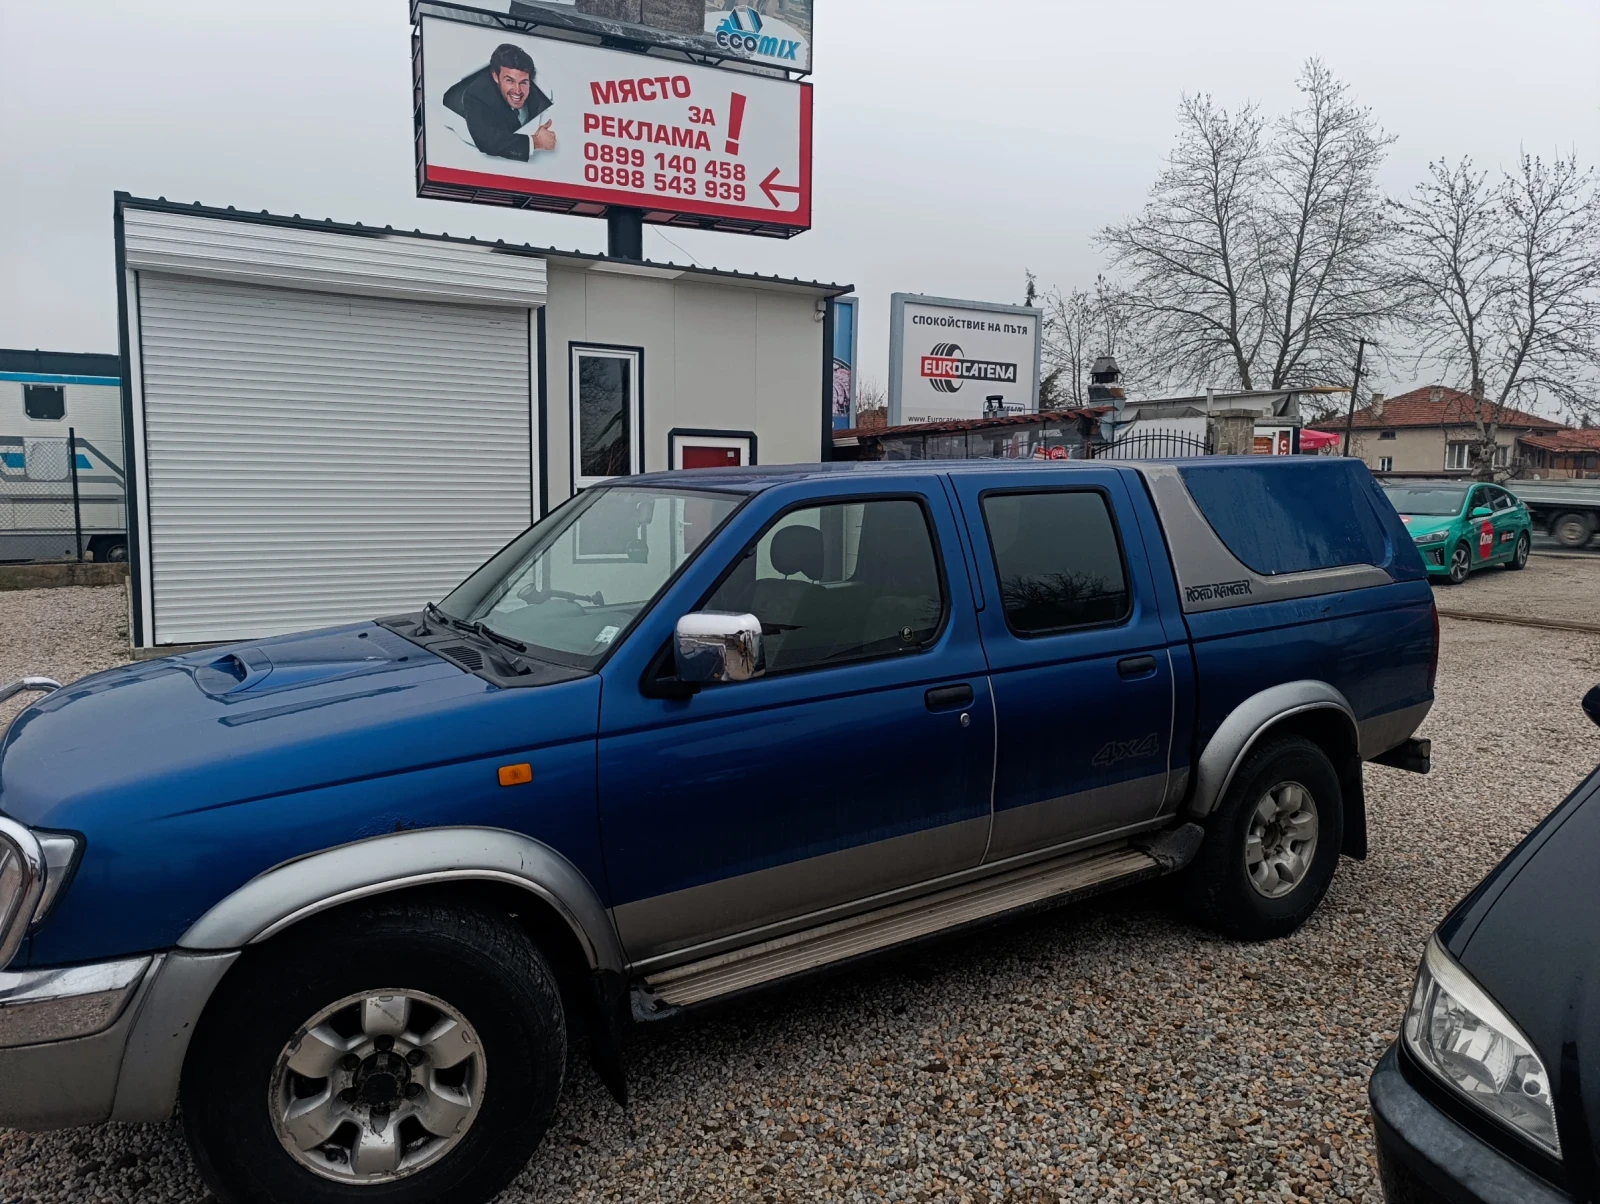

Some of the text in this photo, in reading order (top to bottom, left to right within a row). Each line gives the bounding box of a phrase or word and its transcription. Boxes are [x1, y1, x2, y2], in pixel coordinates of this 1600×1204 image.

[591, 76, 691, 104] МЯСТО
[689, 106, 715, 126] ЗА
[584, 114, 710, 151] РЕКЛАМА
[584, 143, 747, 181] 0899 140 458
[584, 165, 747, 201] 0898 543 939
[912, 315, 1028, 335] СПОКОЙСТВИЕ НА ПЪТЯ
[924, 359, 1014, 380] EUROCATENA
[1479, 532, 1493, 546] One
[1185, 580, 1252, 602] ROAD RANGER
